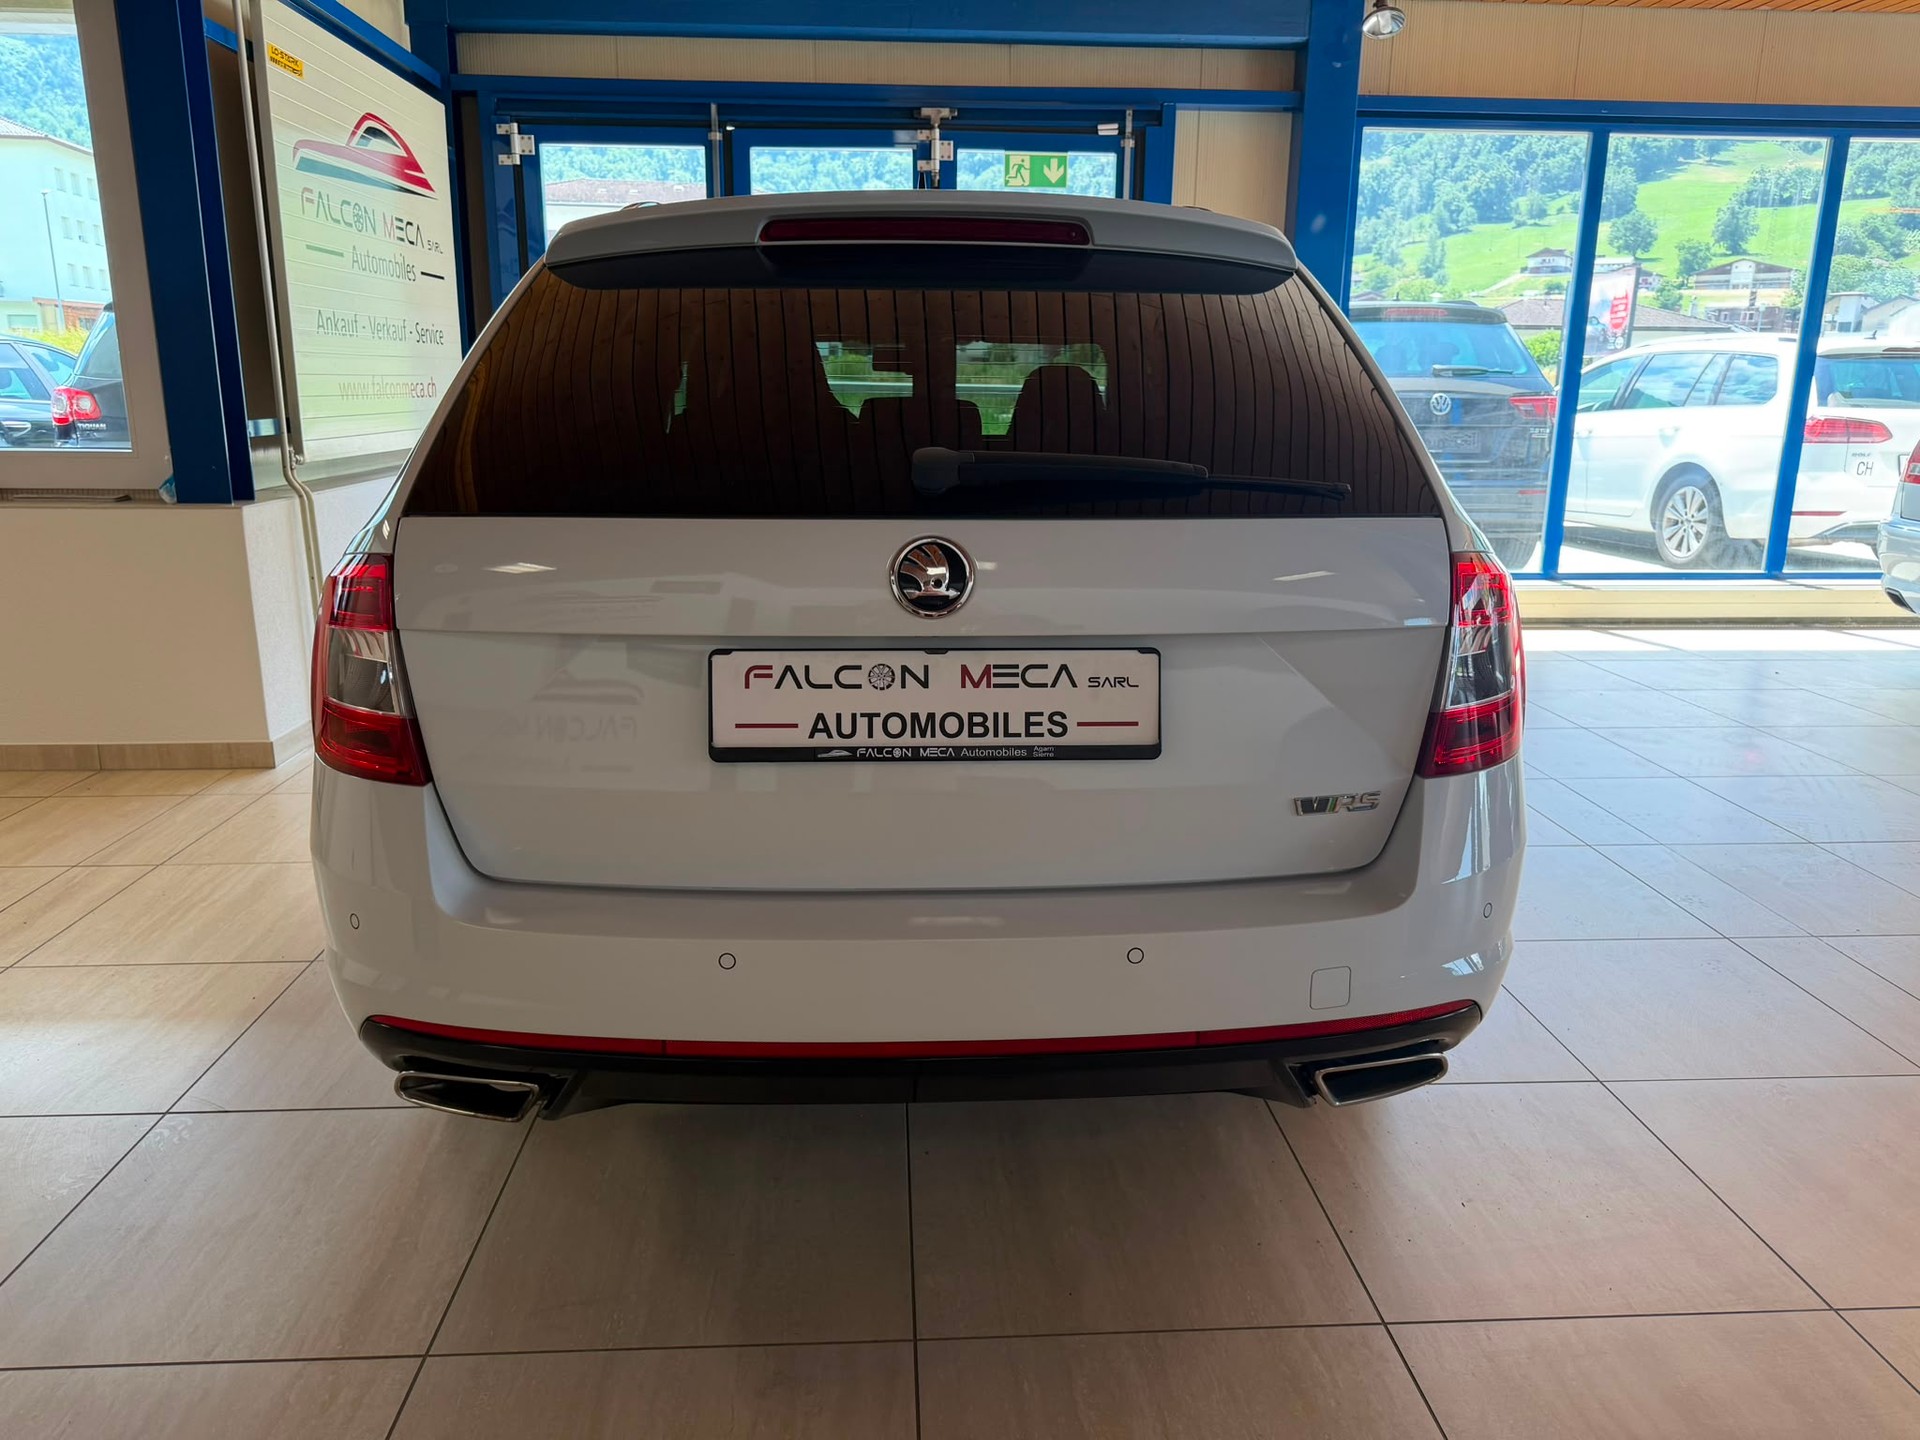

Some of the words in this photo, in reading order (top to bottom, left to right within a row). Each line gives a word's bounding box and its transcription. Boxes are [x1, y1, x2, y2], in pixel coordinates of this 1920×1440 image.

[301, 186, 377, 236] FALCON
[382, 211, 425, 249] MECA
[427, 239, 444, 254] SARL
[351, 245, 416, 282] Automobiles
[316, 309, 359, 336] Ankauf
[368, 315, 407, 342] Verkauf
[415, 321, 444, 345] Service
[338, 375, 438, 400] www.falconmeca.ch
[1856, 461, 1874, 476] CH
[744, 663, 929, 691] FALCON
[960, 663, 1078, 689] MECA
[1087, 676, 1139, 688] SARL
[808, 711, 1068, 739] AUTOMOBILES
[856, 748, 912, 758] FALCON
[920, 748, 955, 757] MECA
[961, 747, 1027, 757] Automobiles
